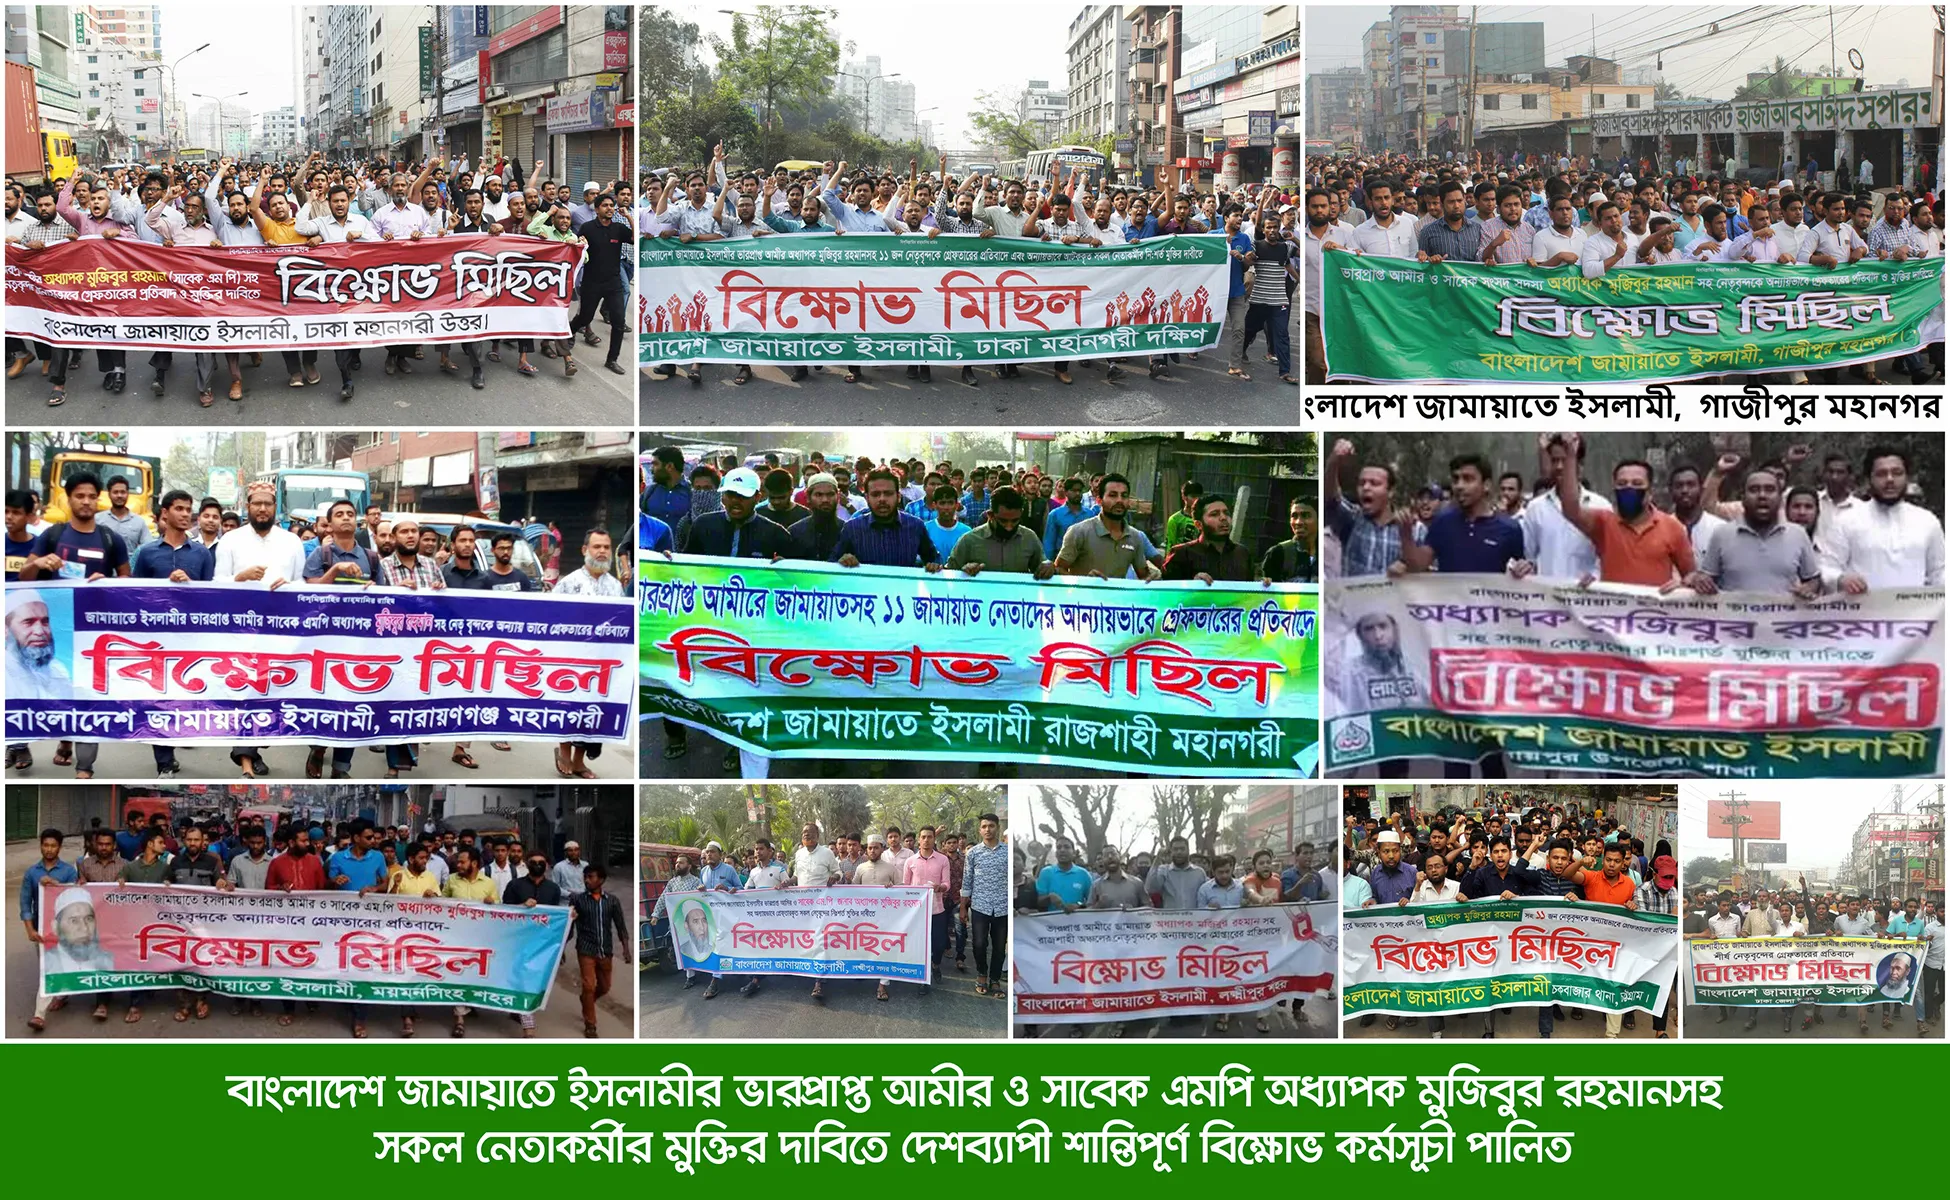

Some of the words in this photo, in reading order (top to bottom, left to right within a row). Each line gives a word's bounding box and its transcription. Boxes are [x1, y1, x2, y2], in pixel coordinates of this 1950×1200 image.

[641, 250, 674, 262] বাংলাদেশ
[676, 249, 703, 260] জামায়াতে
[737, 250, 763, 261] ভারপ্রাপ্ত
[765, 248, 785, 260] আমীর
[788, 250, 816, 261] অধ্যাপক
[819, 248, 842, 263] মুজিবুর
[879, 251, 889, 261] ১১
[980, 248, 1008, 261] প্রতিবাদে
[1011, 251, 1024, 261] এবং
[1095, 251, 1110, 261] সকল
[44, 271, 84, 286] অধ্যাপক
[87, 267, 128, 287] মুজিবুর
[169, 271, 203, 284] (সাবেক
[206, 272, 221, 284] এম
[225, 269, 241, 285] পি)
[244, 273, 258, 284] সহ
[275, 256, 441, 306] বিক্ষোভ
[451, 251, 571, 302] মিছিল
[1340, 267, 1385, 282] ভারপ্রাপ্ত
[1389, 269, 1424, 284] আমীর
[1547, 276, 1601, 292] অধ্যাপক
[1608, 276, 1649, 294] মুজিবুর
[1655, 275, 1694, 292] রহমান
[1698, 278, 1713, 290] সহ
[139, 287, 176, 301] প্রতিবাদ
[225, 287, 260, 300] দাবিতে
[715, 269, 923, 331] বিক্ষোভ
[934, 270, 1092, 332] মিছিল
[45, 317, 116, 340] বাংলাদেশ
[124, 322, 209, 342] জামায়াতে
[217, 317, 298, 342] ইসলামী,
[305, 321, 348, 338] ঢাকা
[355, 312, 434, 337] মহানগরী
[1494, 296, 1724, 339] বিক্ষোভ
[1736, 291, 1896, 335] মিছিল
[719, 336, 846, 358] জামায়াতে
[853, 334, 962, 360] ইসলামী,
[974, 336, 1031, 356] ঢাকা
[1039, 326, 1139, 354] মহানগরী
[1146, 325, 1208, 345] দক্ষিণ
[1478, 351, 1585, 373] বাংলাদেশ
[1590, 351, 1681, 372] জামায়াতে
[1688, 344, 1765, 368] ইসলামী,
[1773, 339, 1833, 361] গাজীপুর
[85, 612, 137, 625] জামায়াতে
[141, 609, 186, 626] ইসলামীর
[189, 612, 229, 626] ভারপ্রাপ্ত
[233, 611, 263, 627] আমীর
[267, 615, 299, 629] সাবেক
[303, 613, 329, 629] এমপি
[332, 616, 371, 630] অধ্যাপক
[434, 619, 446, 632] সহ
[703, 575, 770, 619] আমীরে
[774, 585, 877, 626] জামায়াতসহ
[884, 593, 905, 624] ১১
[912, 591, 983, 626] জামায়াত
[989, 598, 1055, 628] নেতাদের
[1163, 604, 1245, 636] গ্রেফতারের
[1248, 599, 1316, 638] প্রতিবাদে
[1406, 603, 1570, 629] অধ্যাপক
[1772, 619, 1937, 640] রহমান
[81, 633, 402, 695] বিক্ষোভ
[413, 639, 623, 699] মিছিল
[654, 627, 1012, 689] বিক্ষোভ
[1028, 639, 1286, 711] মিছিল
[1439, 652, 1680, 719] বিক্ষোভ
[1702, 669, 1932, 724] মিছিল
[6, 707, 136, 732] বাংলাদেশ
[144, 707, 272, 732] জামায়াতে
[281, 701, 380, 734] ইসলামী,
[389, 706, 499, 728] নারায়ণগঞ্জ
[506, 703, 604, 730] মহানগরী
[781, 705, 922, 741] জামায়াতে
[929, 702, 1036, 743] ইসলামী
[1042, 713, 1162, 759] রাজশাহী
[1169, 719, 1286, 762] মহানগরী
[1380, 714, 1551, 748] বাংলাদেশ
[1764, 731, 1929, 763] ইসলামী
[312, 916, 381, 929] গ্রেফতারের
[331, 900, 359, 911] সাবেক
[398, 902, 442, 915] অধ্যাপক
[1427, 913, 1461, 924] অধ্যাপক
[1464, 910, 1492, 922] মুজিবুর
[1494, 910, 1521, 919] রহমান
[1535, 911, 1546, 920] ১১
[134, 923, 321, 972] বিক্ষোভ
[335, 930, 493, 980] মিছিল
[731, 922, 815, 950] বিক্ষোভ
[822, 924, 907, 957] মিছিল
[1370, 934, 1500, 973] বিক্ষোভ
[1508, 925, 1623, 972] মিছিল
[1820, 949, 1855, 958] প্রতিবাদে
[735, 959, 772, 970] বাংলাদেশ
[775, 960, 811, 971] জামায়াতে
[813, 959, 849, 974] ইসলামী,
[1051, 950, 1167, 985] বিক্ষোভ
[1176, 945, 1270, 982] মিছিল
[1694, 963, 1790, 983] বিক্ষোভ
[1796, 959, 1873, 982] মিছিল
[77, 973, 173, 988] বাংলাদেশ
[280, 977, 362, 1000] ইসলামী,
[472, 990, 514, 1006] শহর
[1022, 996, 1086, 1011] বাংলাদেশ
[1092, 994, 1155, 1009] জামায়াতে
[1406, 982, 1487, 1009] জামায়াতে
[1490, 974, 1552, 999] ইসলামী
[1595, 989, 1619, 1006] থানা,
[1697, 987, 1758, 998] বাংলাদেশ
[1762, 987, 1822, 997] জামায়াতে
[1826, 984, 1875, 996] ইসলামী
